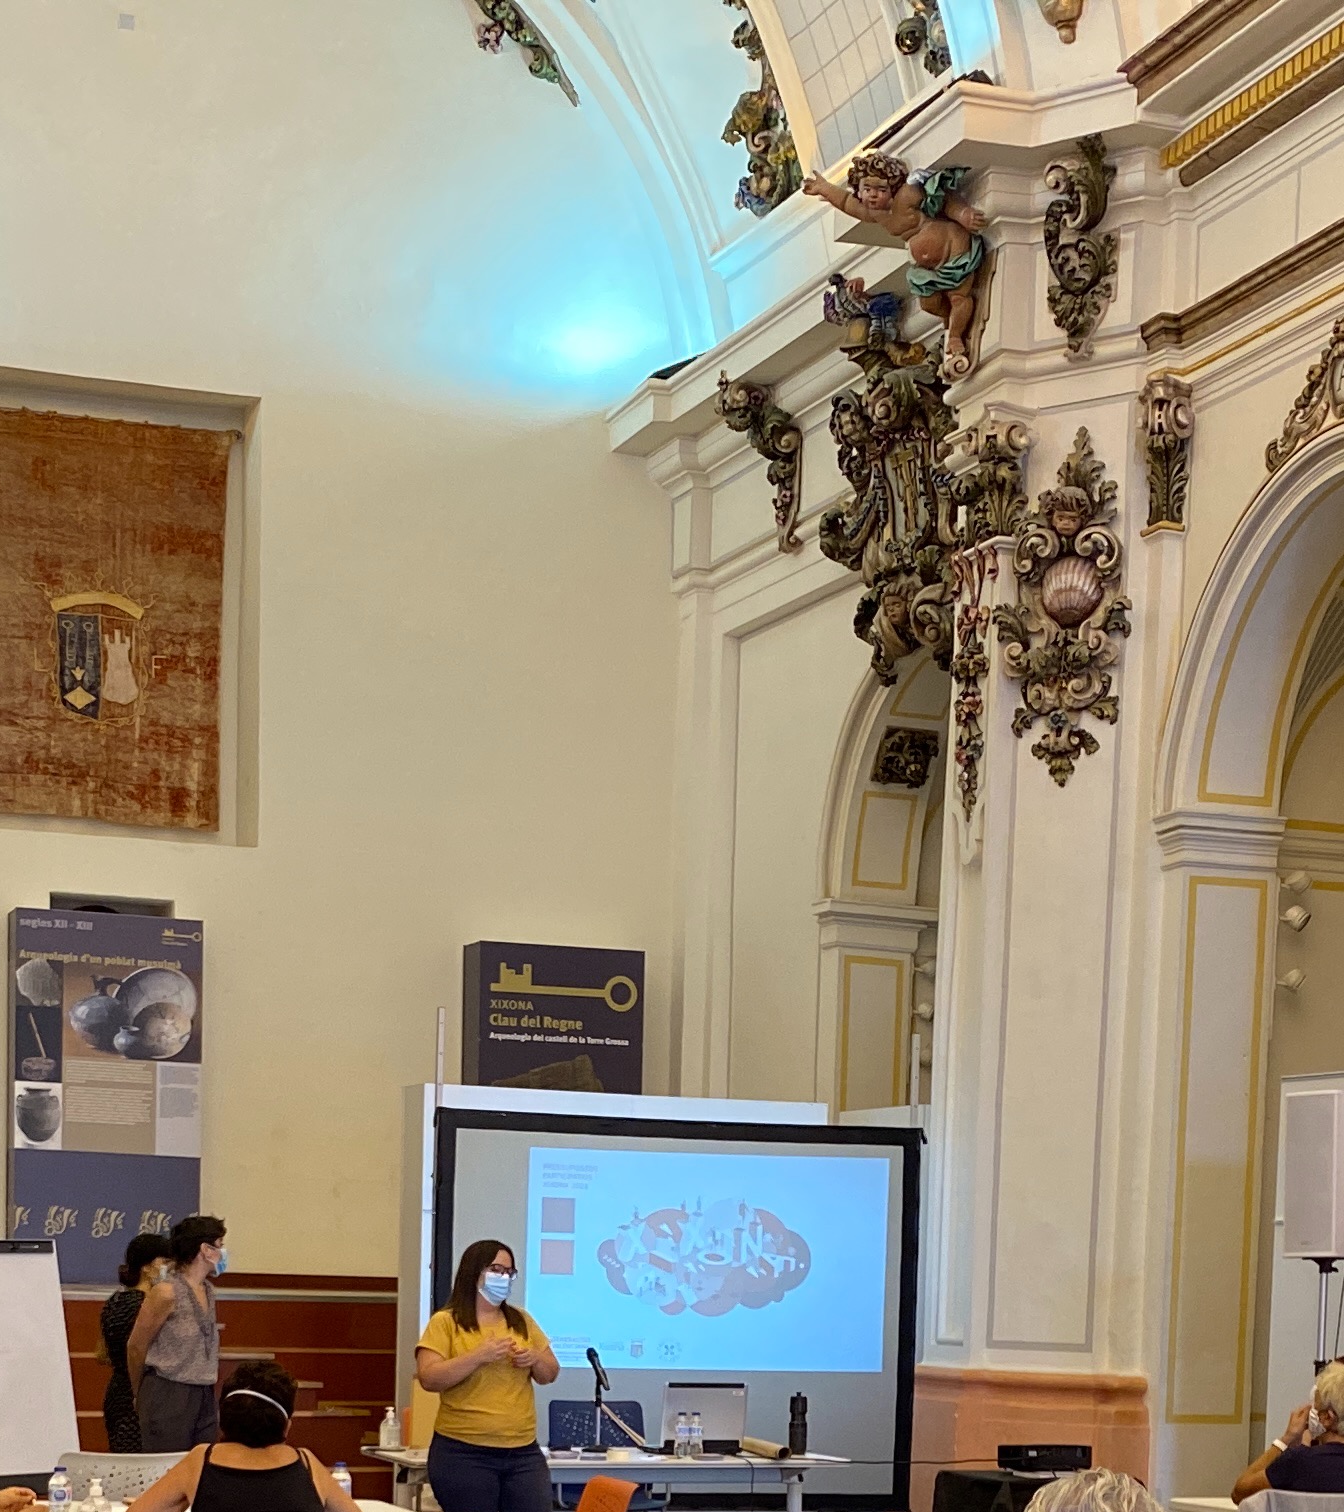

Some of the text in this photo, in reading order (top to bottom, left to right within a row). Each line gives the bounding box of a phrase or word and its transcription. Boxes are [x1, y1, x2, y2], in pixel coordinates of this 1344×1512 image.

[152, 655, 168, 678] F
[489, 1000, 534, 1011] XIXONA
[489, 1013, 583, 1032] Clau del Regne
